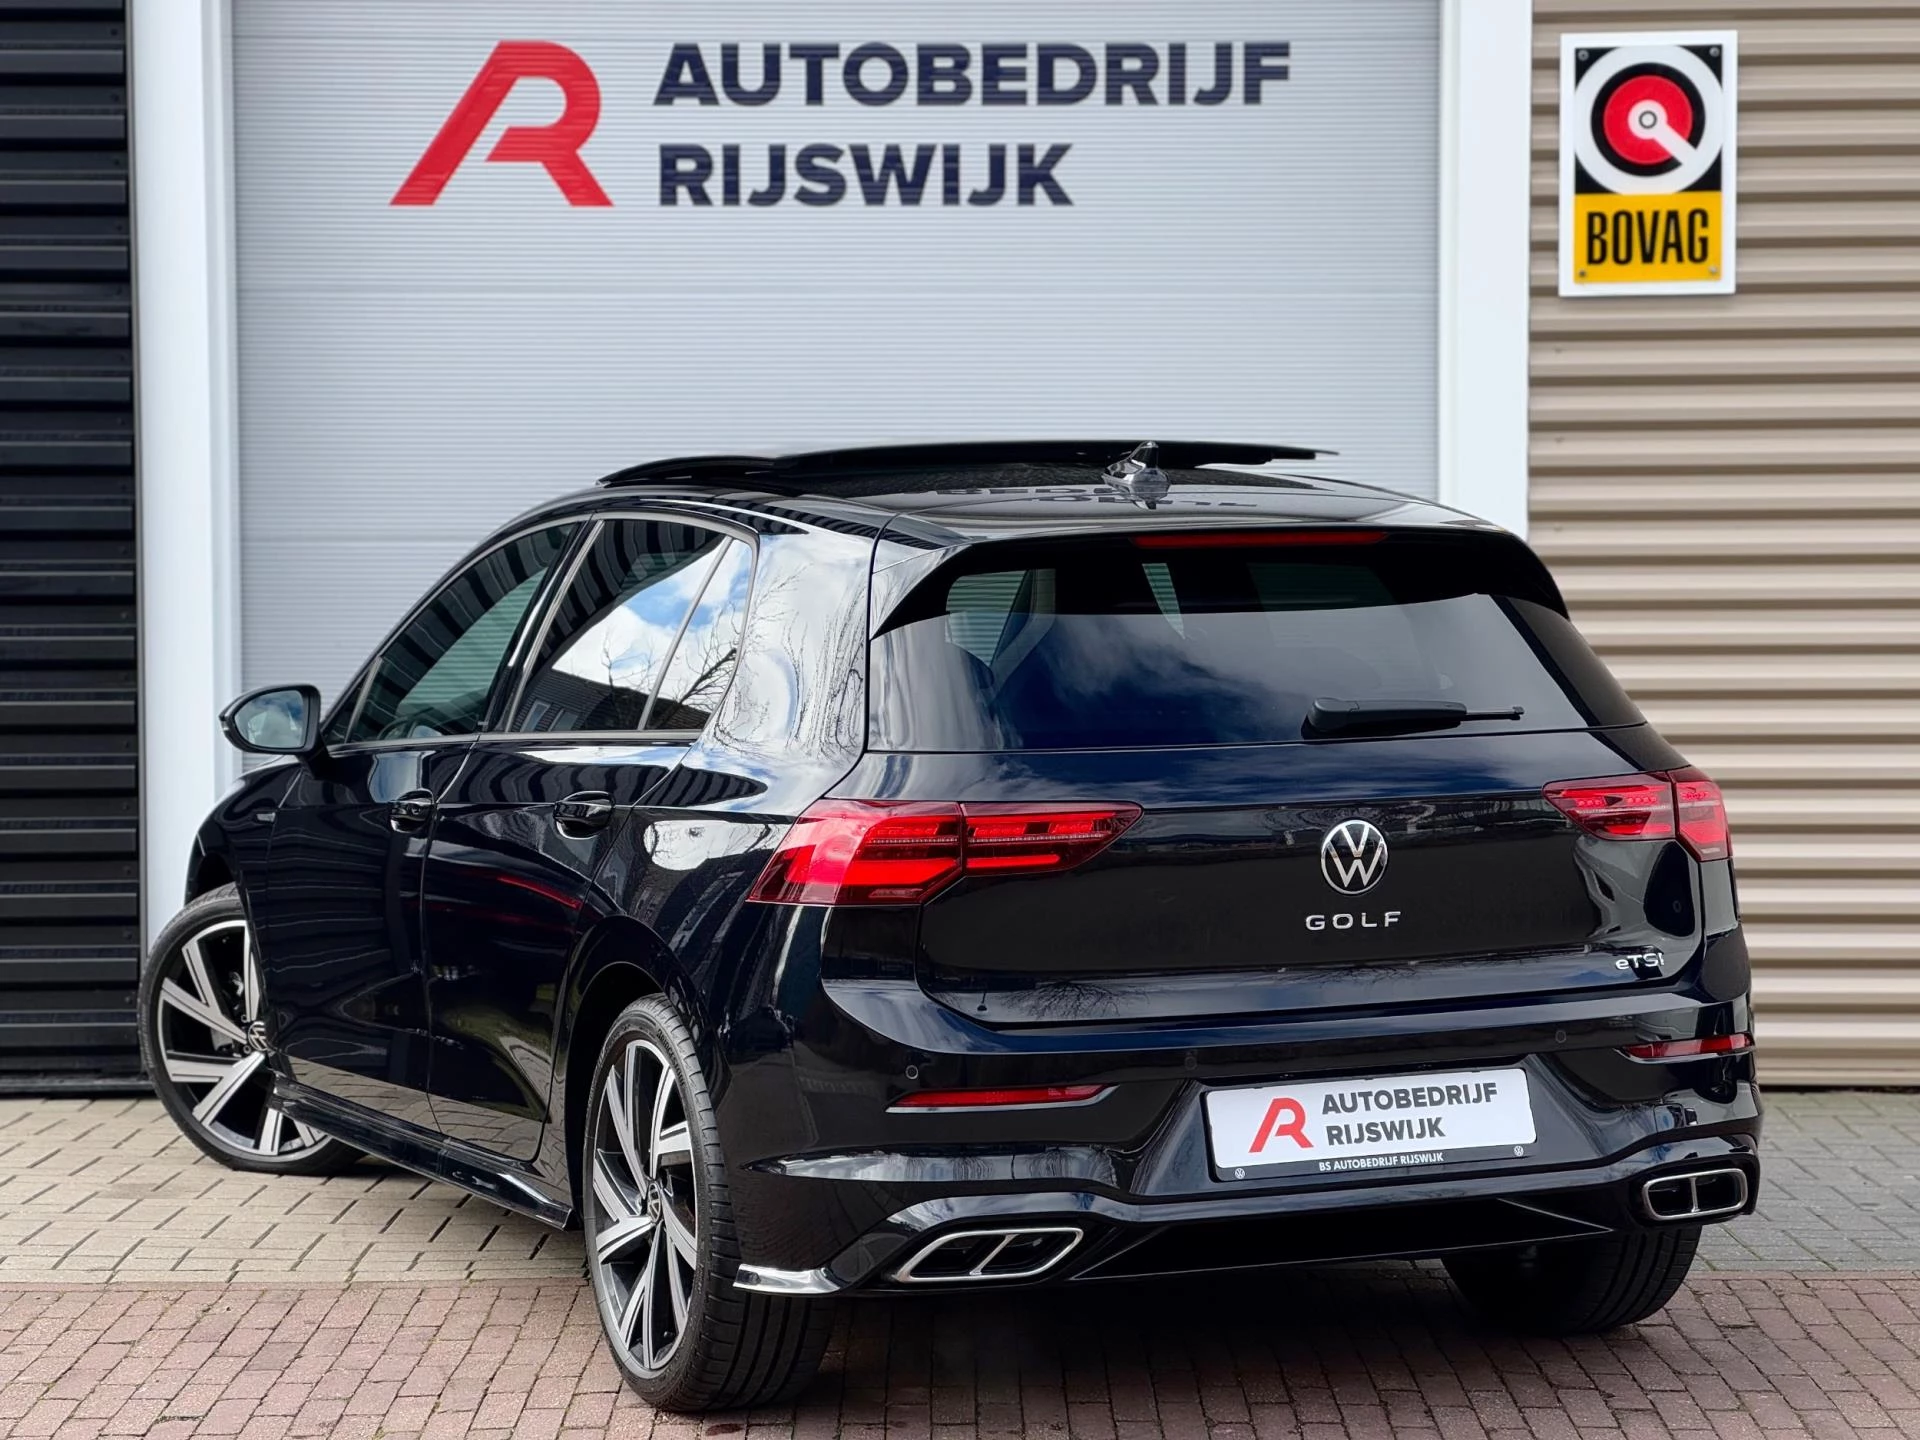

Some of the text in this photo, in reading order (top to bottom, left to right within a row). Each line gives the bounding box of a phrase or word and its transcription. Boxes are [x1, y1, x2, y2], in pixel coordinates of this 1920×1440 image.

[654, 42, 1290, 106] AUTOBEDRIJF
[659, 144, 1073, 206] RIJSWIJK
[1586, 208, 1709, 265] BOVAG
[1305, 911, 1401, 931] GOLF
[1322, 1082, 1498, 1115] AUTOBEDRIJF
[1326, 1117, 1446, 1146] RIJSWIJK
[1319, 1152, 1445, 1172] BS AUTOBEDRIJF RIJSWIJK
